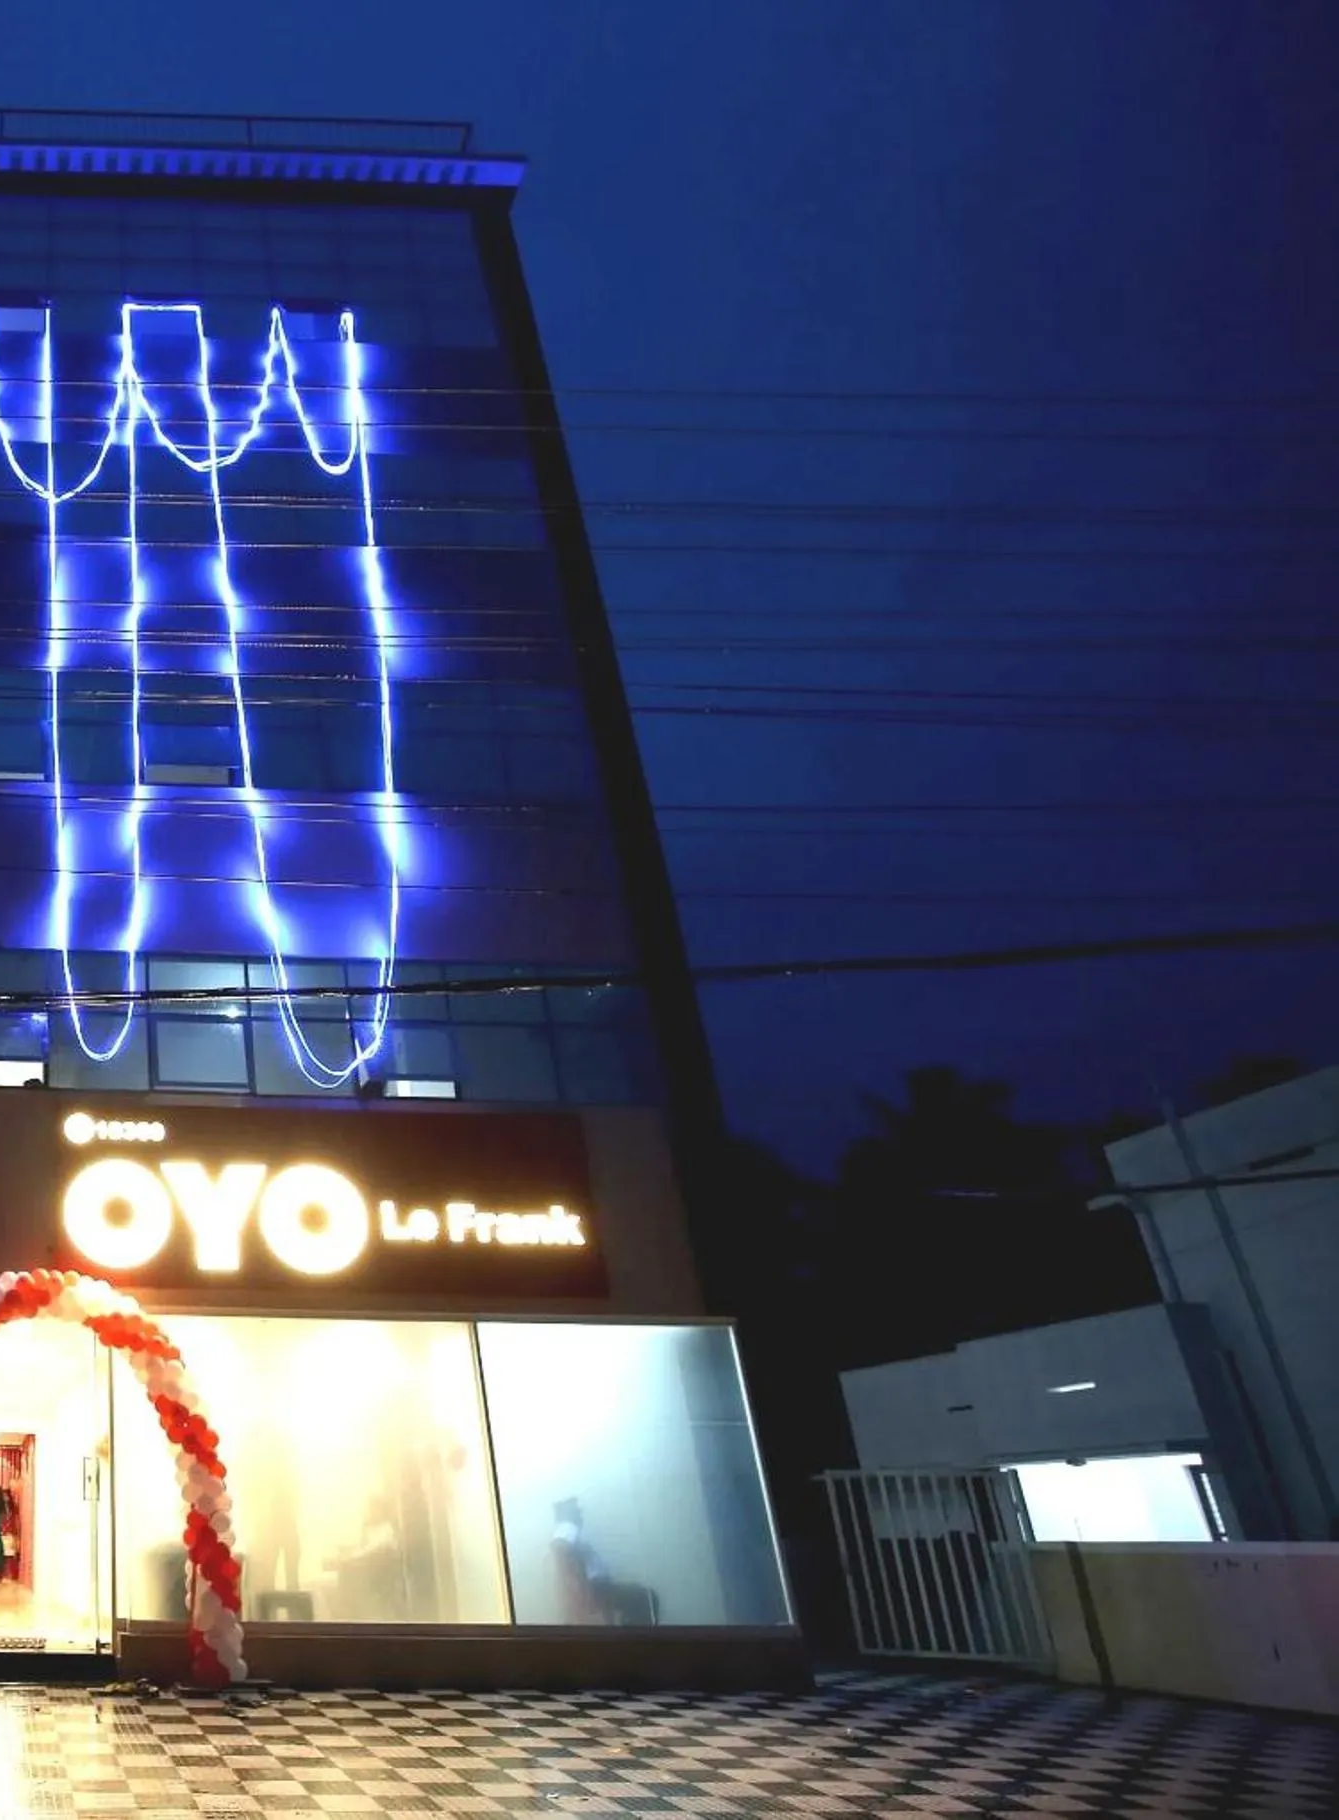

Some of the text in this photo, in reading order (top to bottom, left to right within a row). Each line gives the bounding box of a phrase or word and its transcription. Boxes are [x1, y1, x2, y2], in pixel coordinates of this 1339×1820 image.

[62, 1157, 586, 1275] OYO Le Frank
